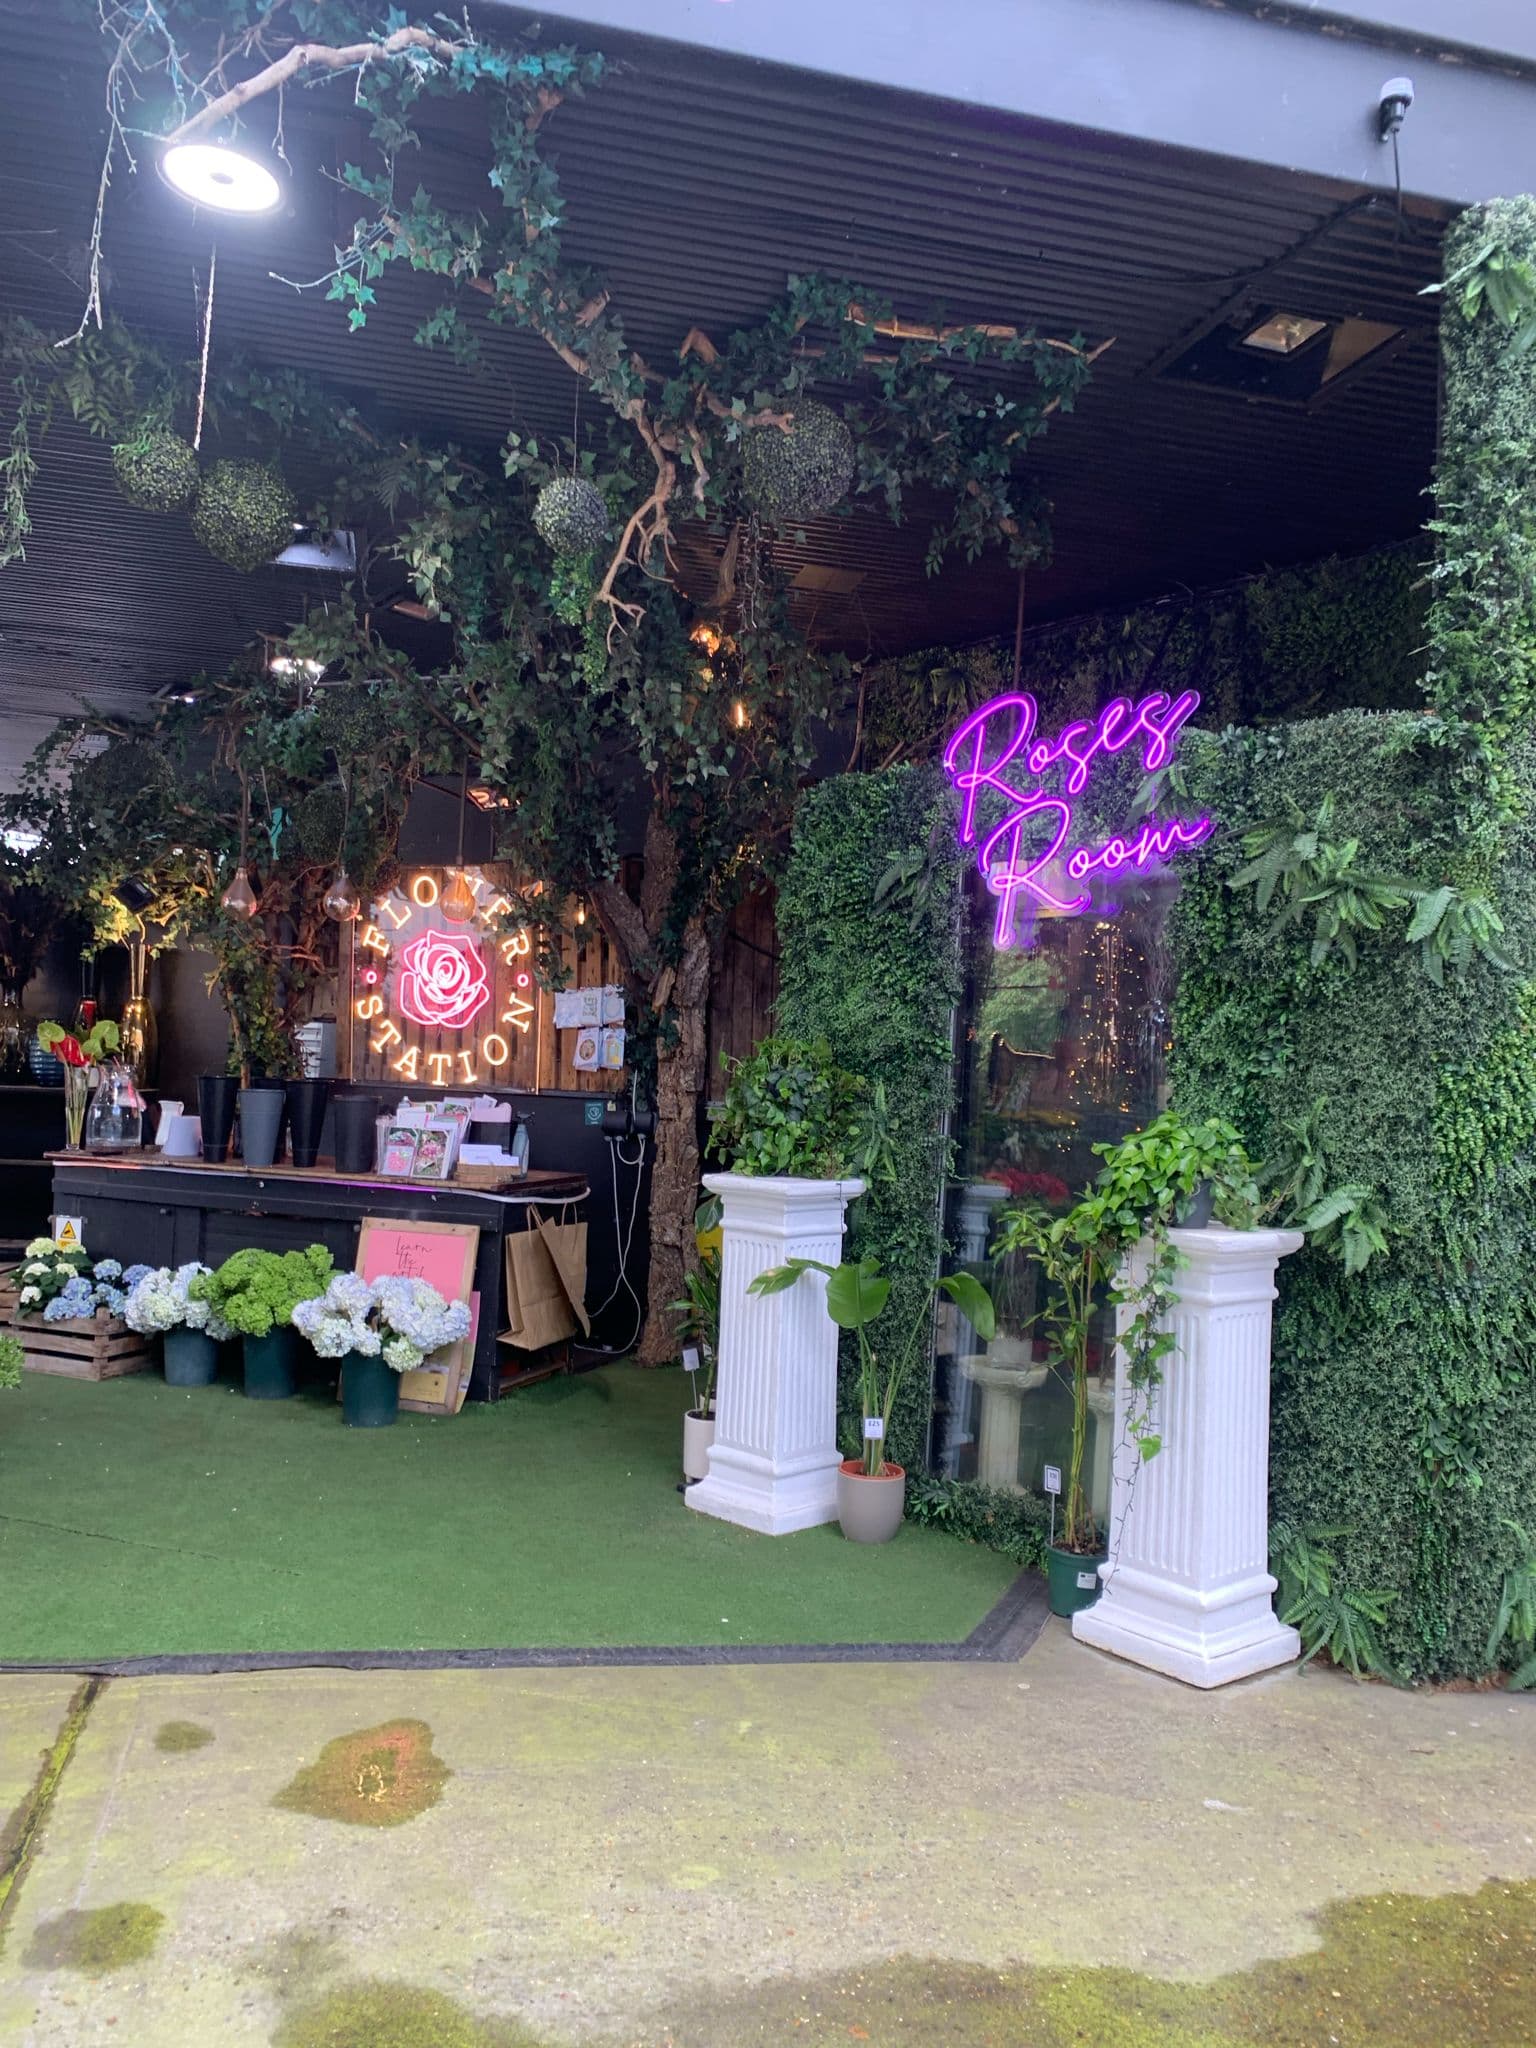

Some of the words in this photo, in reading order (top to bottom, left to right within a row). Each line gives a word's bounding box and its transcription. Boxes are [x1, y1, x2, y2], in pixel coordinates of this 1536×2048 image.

[947, 694, 1195, 843] Roses
[982, 799, 1210, 944] Room
[357, 992, 535, 1086] STATION
